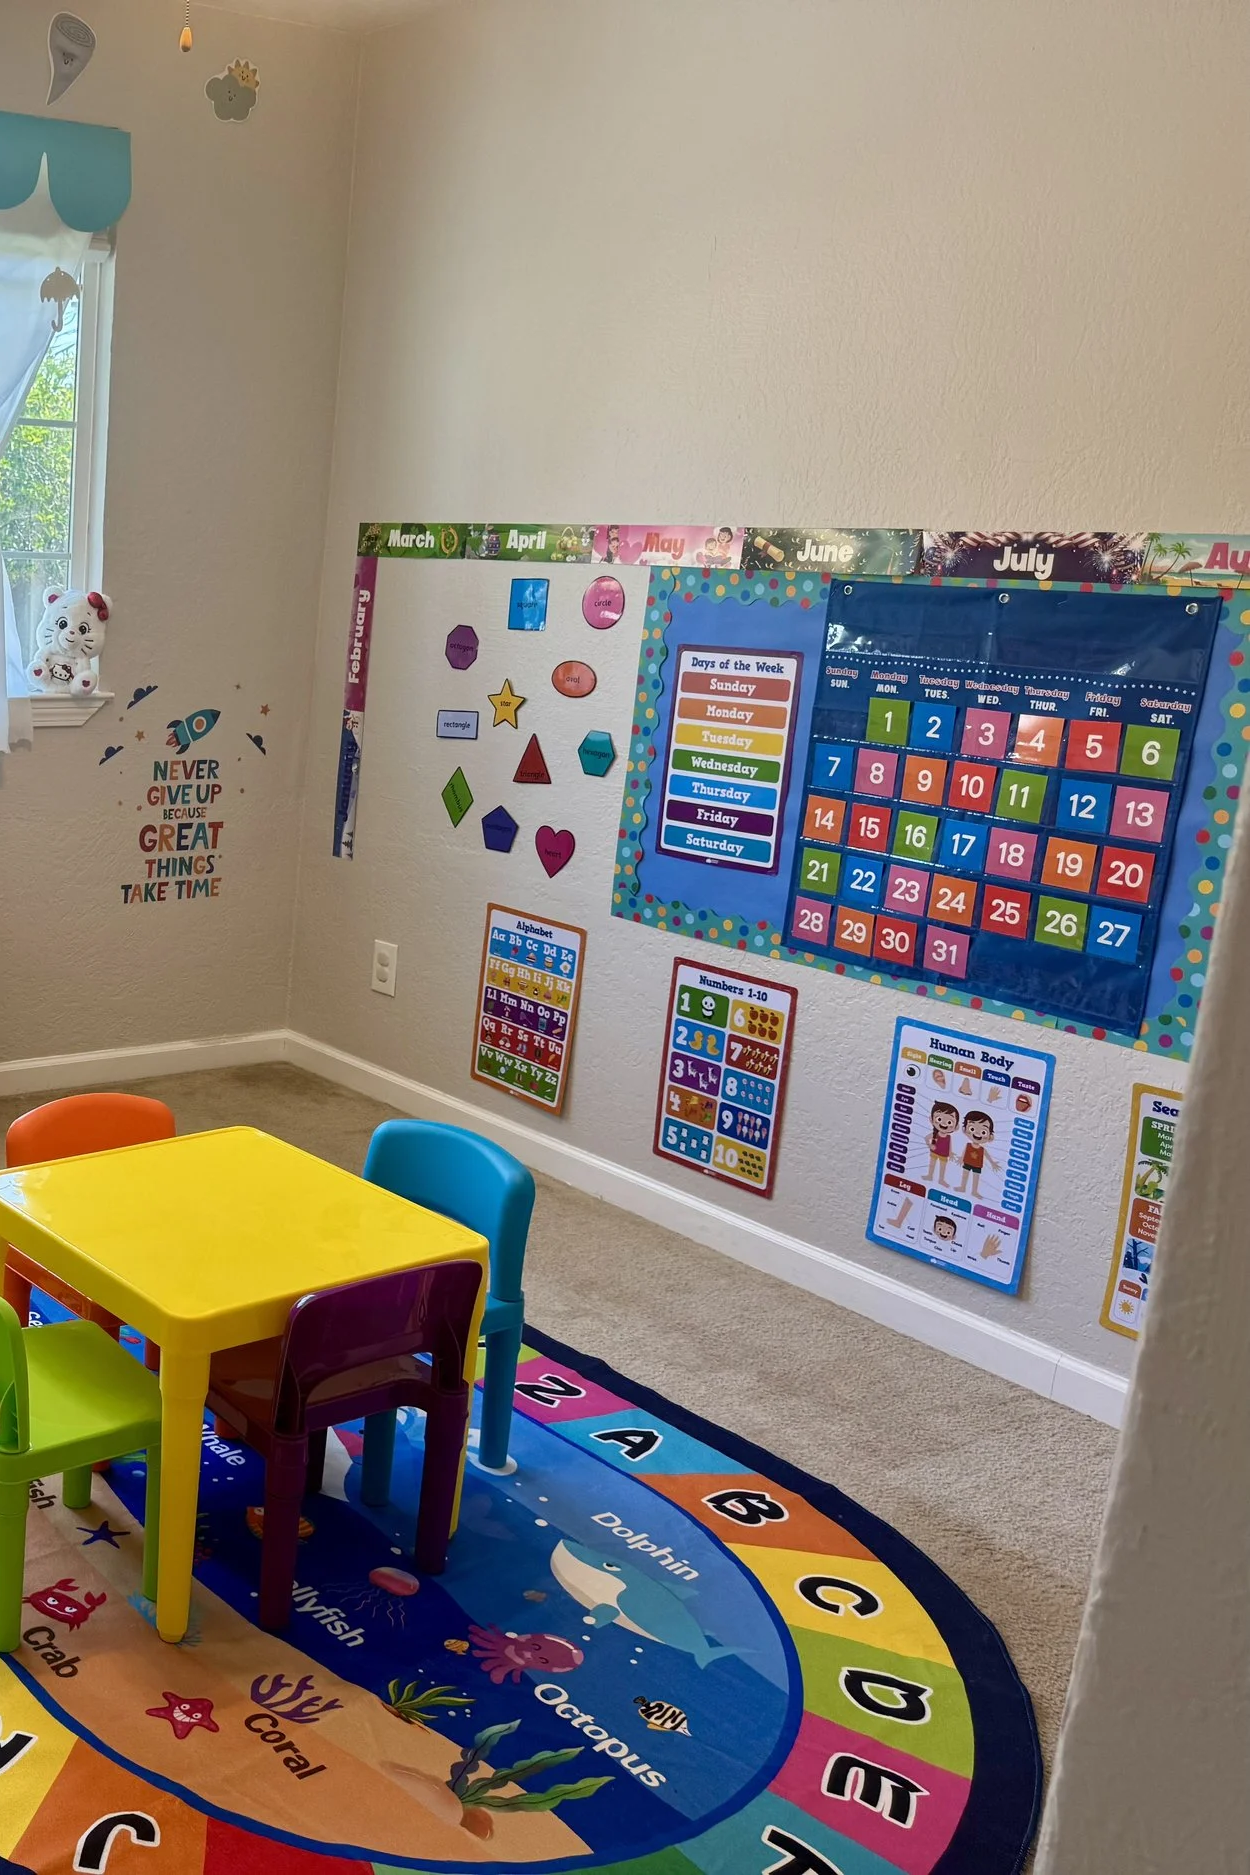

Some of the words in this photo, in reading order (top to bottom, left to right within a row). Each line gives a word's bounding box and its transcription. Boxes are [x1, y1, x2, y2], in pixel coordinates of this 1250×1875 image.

[388, 529, 435, 548] March
[506, 529, 547, 552] April
[643, 531, 686, 558] May
[797, 539, 854, 564] June
[993, 546, 1055, 581] July
[594, 598, 612, 608] circle
[348, 588, 371, 684] February
[691, 656, 716, 671] Days
[719, 659, 731, 670] of
[733, 659, 751, 672] the
[755, 661, 785, 675] Week
[825, 666, 859, 680] Sunday
[565, 675, 581, 685] oval
[709, 678, 757, 697] Sunday
[830, 678, 851, 690] SUN.
[870, 670, 909, 685] Monday
[918, 674, 960, 691] Tuesday
[964, 679, 1020, 696] Wednesday
[876, 683, 900, 695] MON.
[924, 687, 951, 701] TUES.
[1023, 685, 1070, 701] Thursday
[1084, 691, 1122, 707] Friday
[500, 699, 512, 708] star
[976, 693, 1002, 707] WED.
[1029, 699, 1059, 713] THUR.
[1139, 698, 1192, 714] Saturday
[705, 704, 754, 724] Monday
[1088, 705, 1110, 719] FRI.
[1149, 712, 1176, 726] SAT.
[443, 720, 471, 731] rectangle
[701, 730, 754, 751] Tuesday
[884, 711, 894, 733] 1
[926, 716, 941, 738] 2
[978, 723, 996, 746] 3
[1028, 729, 1047, 752] 4
[1085, 735, 1103, 758] 5
[1141, 741, 1161, 766] 6
[582, 748, 611, 760] hexagon
[153, 759, 220, 782] NEVER
[690, 756, 759, 778] Wednesday
[146, 784, 193, 806] GIVE
[196, 783, 222, 804] UP
[691, 781, 752, 804] Thursday
[827, 756, 842, 777] 7
[869, 762, 885, 785] 8
[917, 769, 933, 792] 9
[959, 774, 985, 799] 10
[1008, 784, 1030, 809] 11
[1068, 793, 1097, 820] 12
[1125, 801, 1155, 829] 13
[163, 807, 207, 820] BECAUSE
[695, 807, 739, 828] Friday
[139, 821, 224, 852] GREAT
[685, 833, 745, 857] Saturday
[813, 807, 835, 830] 14
[858, 816, 881, 839] 15
[904, 823, 927, 847] 16
[951, 833, 977, 857] 17
[998, 841, 1025, 868] 18
[1055, 850, 1083, 878] 19
[1107, 860, 1144, 889] 20
[144, 855, 215, 878] THINGS
[121, 881, 169, 904] TAKE
[174, 877, 222, 900] TIME
[806, 859, 830, 882] 21
[850, 867, 877, 894] 22
[891, 878, 921, 904] 23
[936, 887, 967, 914] 24
[989, 898, 1021, 926] 25
[1044, 910, 1078, 938] 26
[1096, 920, 1131, 948] 27
[516, 920, 554, 940] Alphabet
[798, 908, 824, 934] 28
[840, 919, 868, 944] 29
[880, 926, 910, 953] 30
[931, 939, 958, 966] 31
[699, 975, 744, 996] Numbers
[747, 988, 768, 1002] 1-10
[680, 992, 691, 1012] 1
[733, 1007, 746, 1028] 6
[675, 1025, 689, 1046] 2
[730, 1041, 743, 1062] 7
[929, 1037, 976, 1060] Human
[980, 1051, 1015, 1072] Body
[672, 1058, 685, 1079] 3
[724, 1076, 738, 1097] 8
[669, 1090, 681, 1112] 4
[721, 1109, 734, 1130] 9
[666, 1125, 678, 1145] 5
[714, 1143, 739, 1169] 10
[940, 1194, 959, 1207] Head
[986, 1211, 1006, 1224] Hand
[202, 1424, 246, 1466] hale
[590, 1426, 663, 1461] A
[702, 1488, 789, 1527] B
[590, 1510, 702, 1582] Dolphin
[794, 1574, 884, 1620] C
[292, 1580, 366, 1648] llyfish
[21, 1625, 82, 1681] Crab
[839, 1665, 933, 1726] D
[533, 1681, 669, 1791] Octopus
[244, 1712, 327, 1782] Coral
[821, 1750, 930, 1829] E
[72, 1810, 162, 1875] J
